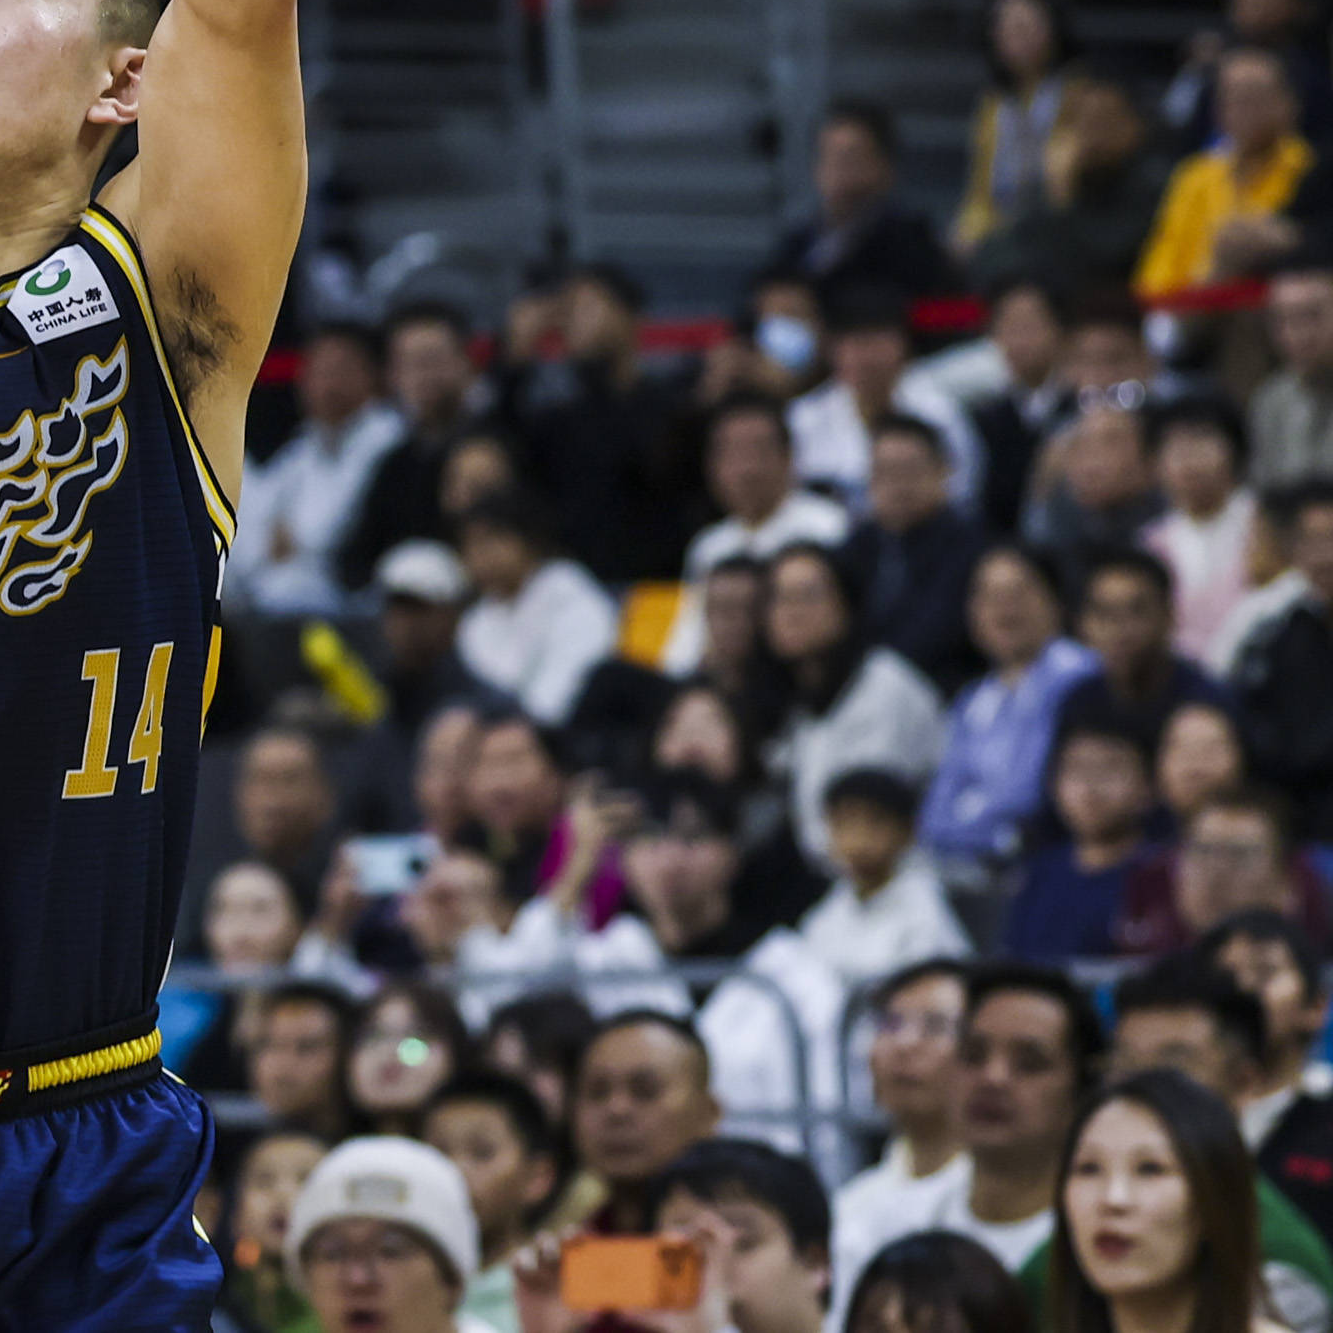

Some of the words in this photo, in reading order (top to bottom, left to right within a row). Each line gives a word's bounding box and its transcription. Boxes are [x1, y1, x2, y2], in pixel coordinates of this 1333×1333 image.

[27, 286, 102, 323] 中国人寿
[35, 312, 77, 333] CHINA
[78, 302, 107, 318] LIFE
[61, 641, 175, 800] 14
